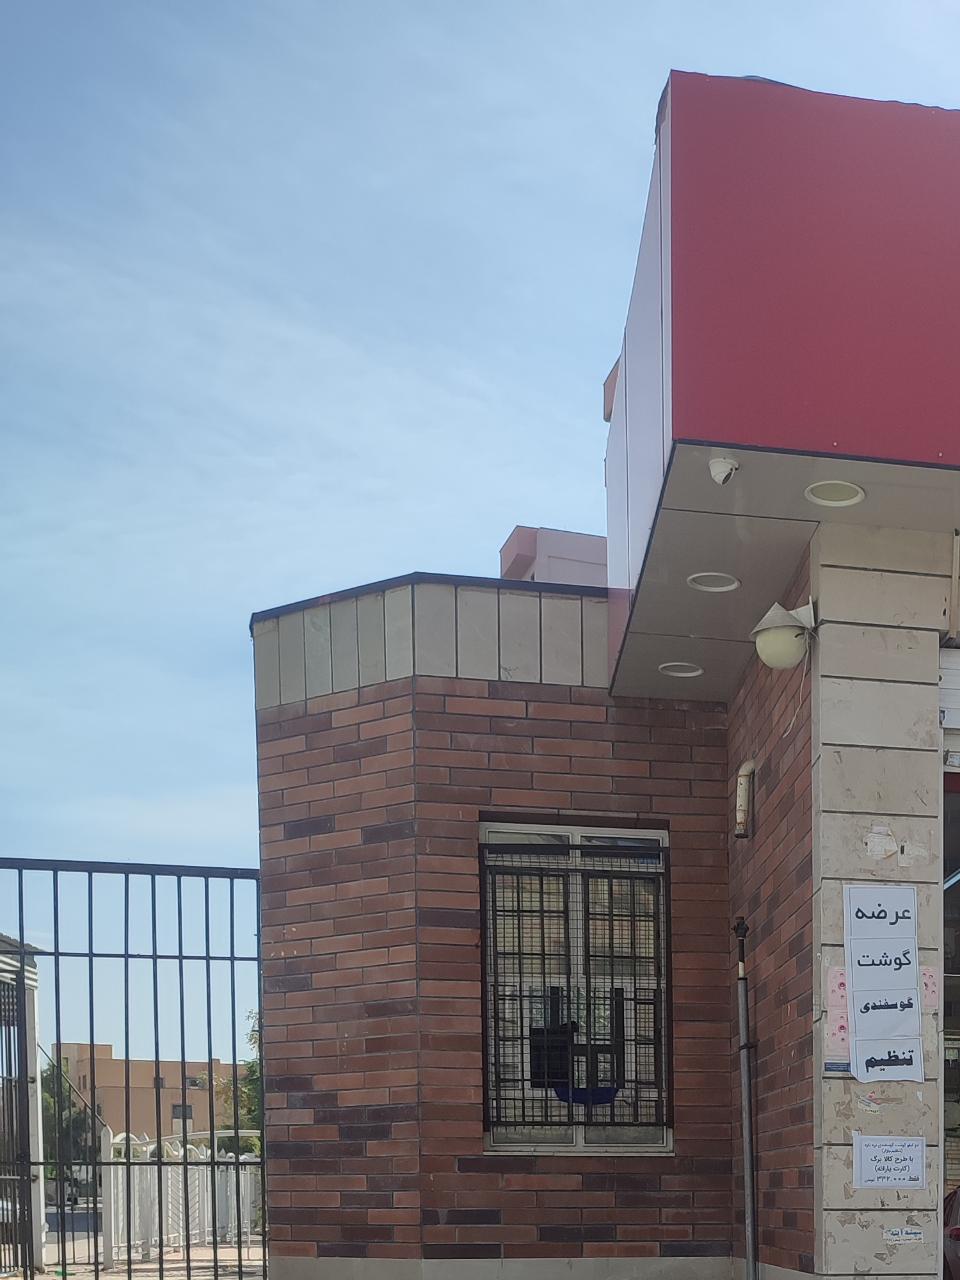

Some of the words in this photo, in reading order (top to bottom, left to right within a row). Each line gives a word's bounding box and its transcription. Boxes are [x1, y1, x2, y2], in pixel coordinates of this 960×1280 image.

[855, 903, 912, 926] عرضه
[857, 949, 912, 971] گوشت
[859, 997, 914, 1014] گوسفندی
[864, 1050, 915, 1073] تنظیم
